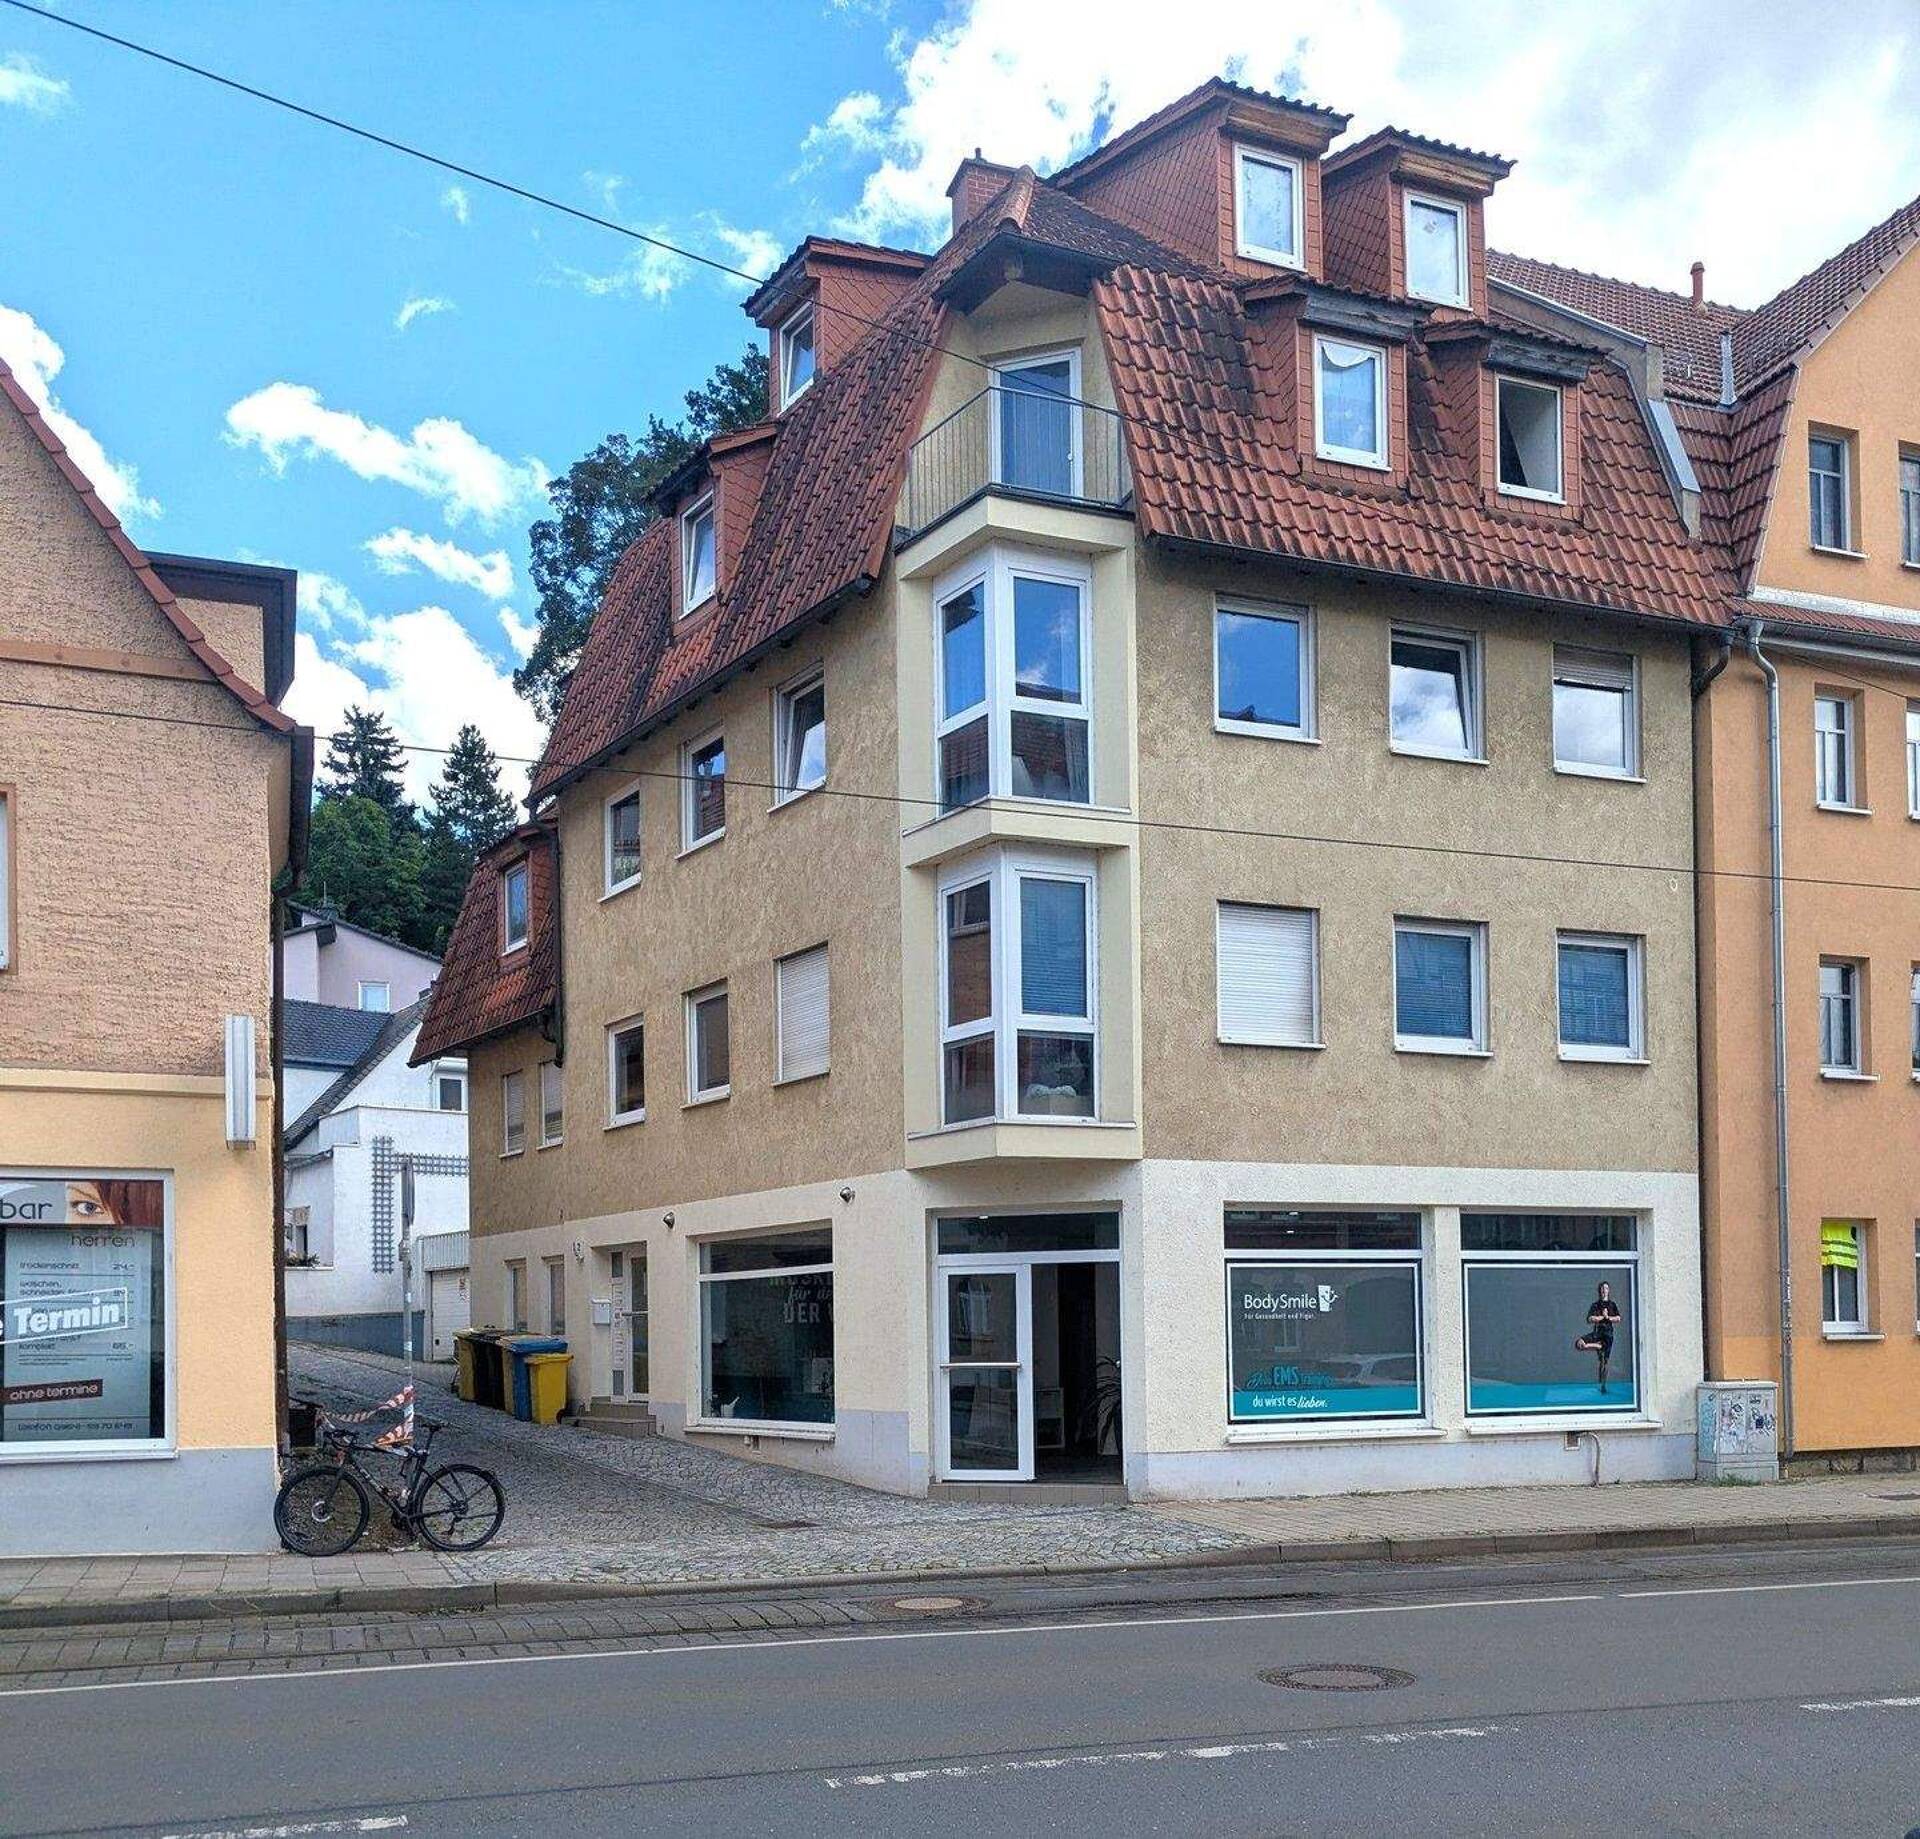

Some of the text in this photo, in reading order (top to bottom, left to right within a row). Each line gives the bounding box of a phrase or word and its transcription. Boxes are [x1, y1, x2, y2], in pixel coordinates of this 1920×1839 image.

[14, 1297, 120, 1336] Termin
[9, 1383, 98, 1401] ohne termine
[1252, 1394, 1263, 1408] du
[1286, 1397, 1297, 1407] es
